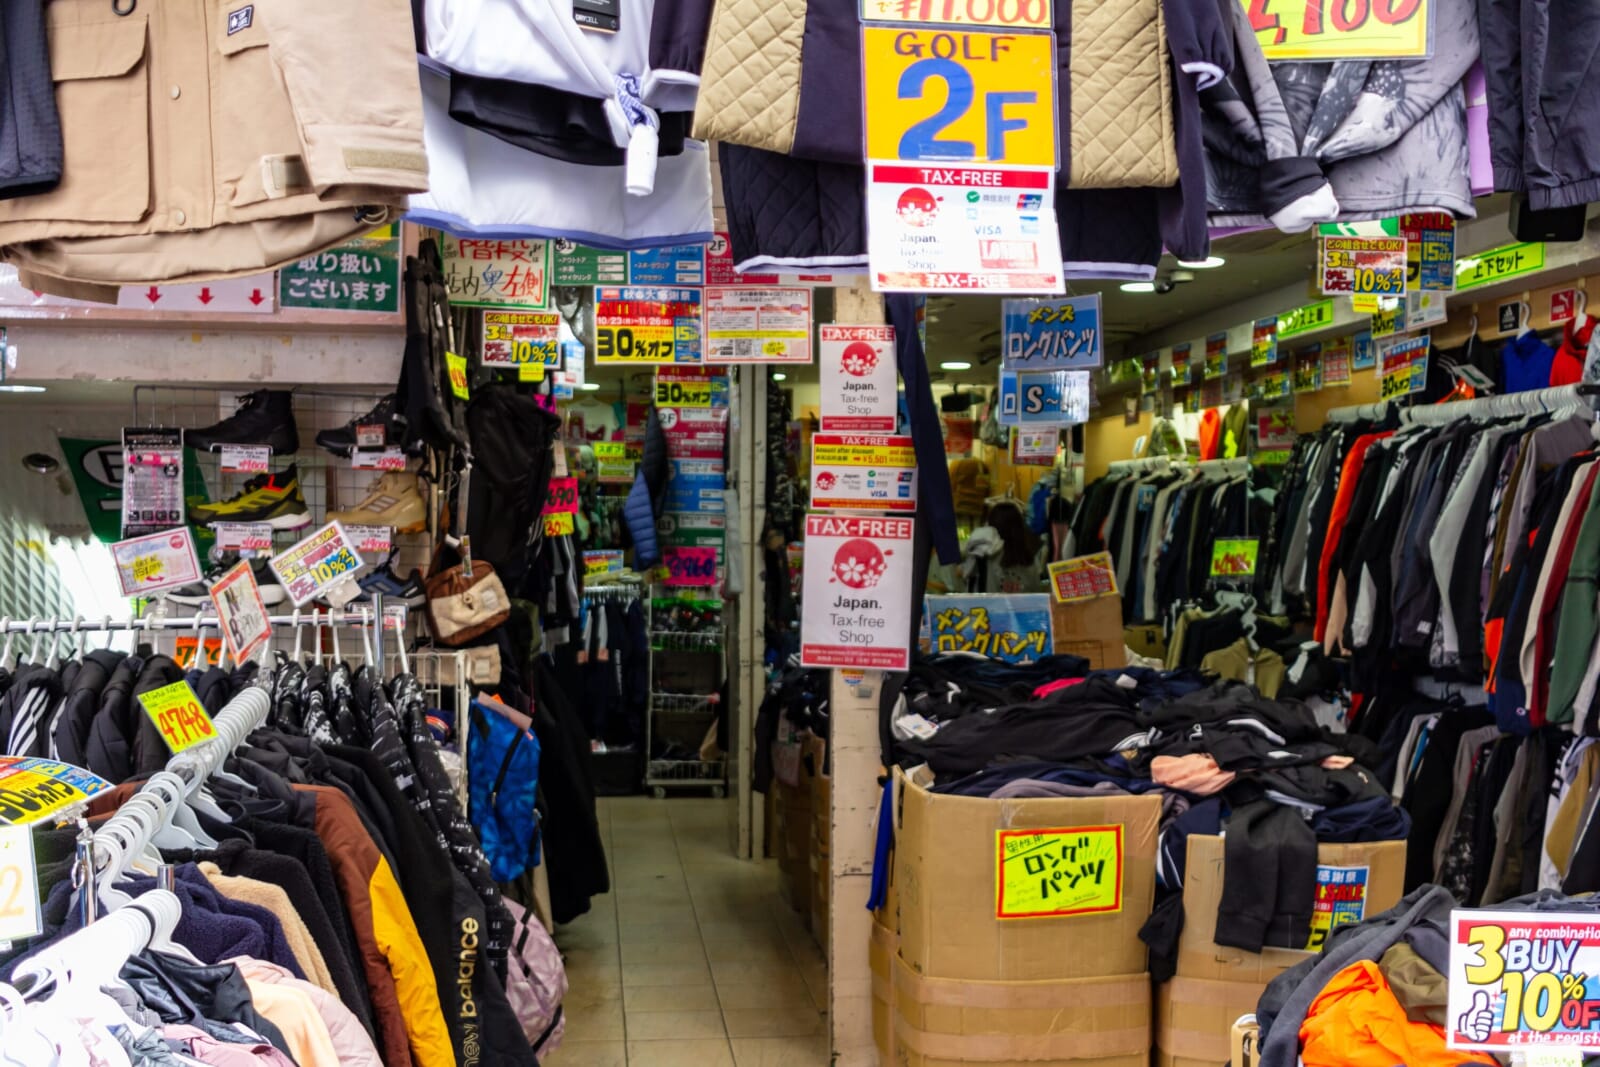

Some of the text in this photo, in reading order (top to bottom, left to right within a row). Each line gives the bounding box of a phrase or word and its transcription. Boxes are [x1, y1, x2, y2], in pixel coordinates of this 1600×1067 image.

[894, 31, 1017, 62] GOLF
[897, 56, 1038, 162] 2F
[921, 168, 1003, 187] TAX-FREE
[975, 225, 1003, 235] VISA
[708, 240, 726, 251] 2F
[298, 253, 382, 274] 取り扱い
[1473, 251, 1525, 279] 上下セット
[288, 277, 392, 302] ございます
[927, 273, 1009, 288] TAX-FREE
[1028, 304, 1075, 325] メンズ
[824, 327, 894, 341] TAX-FREE
[1007, 328, 1096, 361] ロングパンツ
[842, 381, 877, 392] Japan.
[841, 393, 880, 404] Tax-free
[847, 404, 872, 416] Shop
[841, 436, 889, 446] TAX-FREE
[871, 490, 888, 498] VISA
[809, 517, 910, 538] TAX-FREE
[833, 595, 883, 611] Japan.
[829, 612, 885, 629] Tax-free
[936, 606, 989, 632] メンズ
[839, 629, 874, 646] Shop
[937, 631, 1047, 656] ロングパンツ
[1024, 836, 1090, 876] ロング
[1041, 859, 1106, 900] パンツ
[1464, 924, 1507, 986] 3
[1508, 927, 1532, 940] any
[1506, 938, 1581, 974] BUY
[456, 917, 480, 1019] balance
[1501, 970, 1589, 1033] 10%
[1507, 1033, 1523, 1044] at
[1529, 1030, 1551, 1043] the
